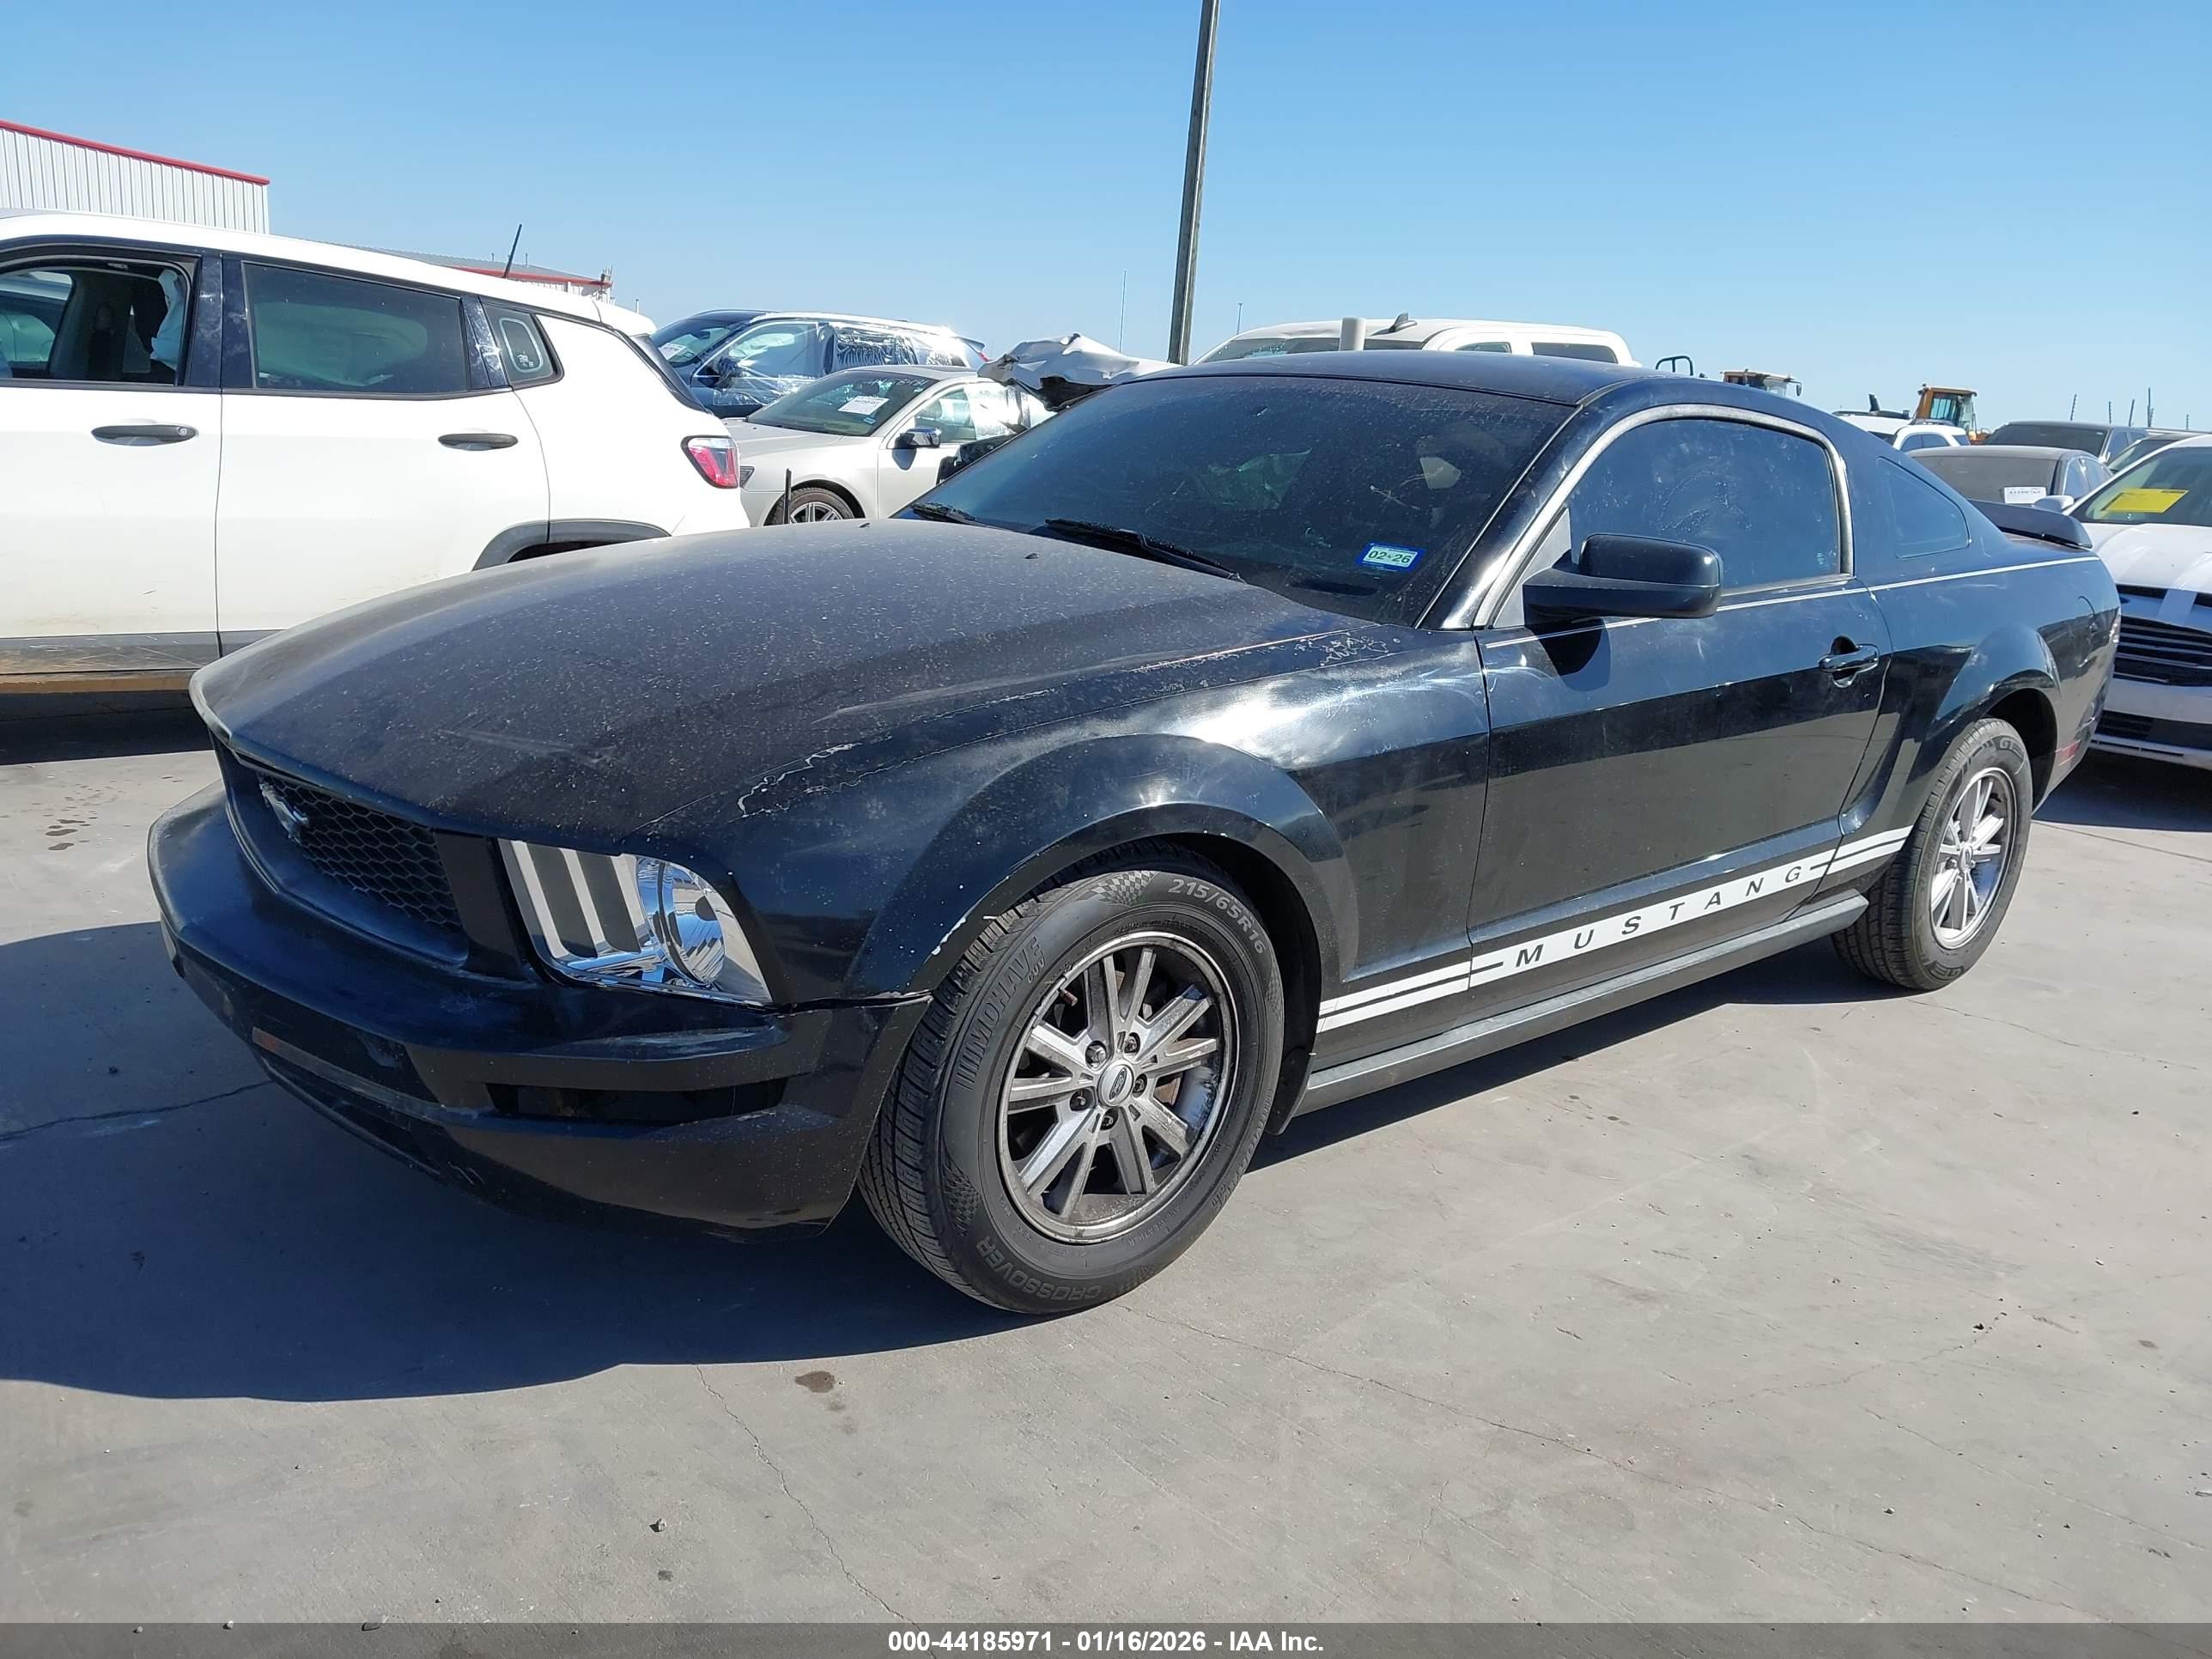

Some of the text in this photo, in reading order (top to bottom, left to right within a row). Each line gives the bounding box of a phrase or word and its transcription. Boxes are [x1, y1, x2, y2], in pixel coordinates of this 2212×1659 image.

[1168, 878, 1267, 954] 215/65R16
[1514, 865, 1804, 969] MUSTANG
[975, 1236, 1103, 1302] CROSSOVER
